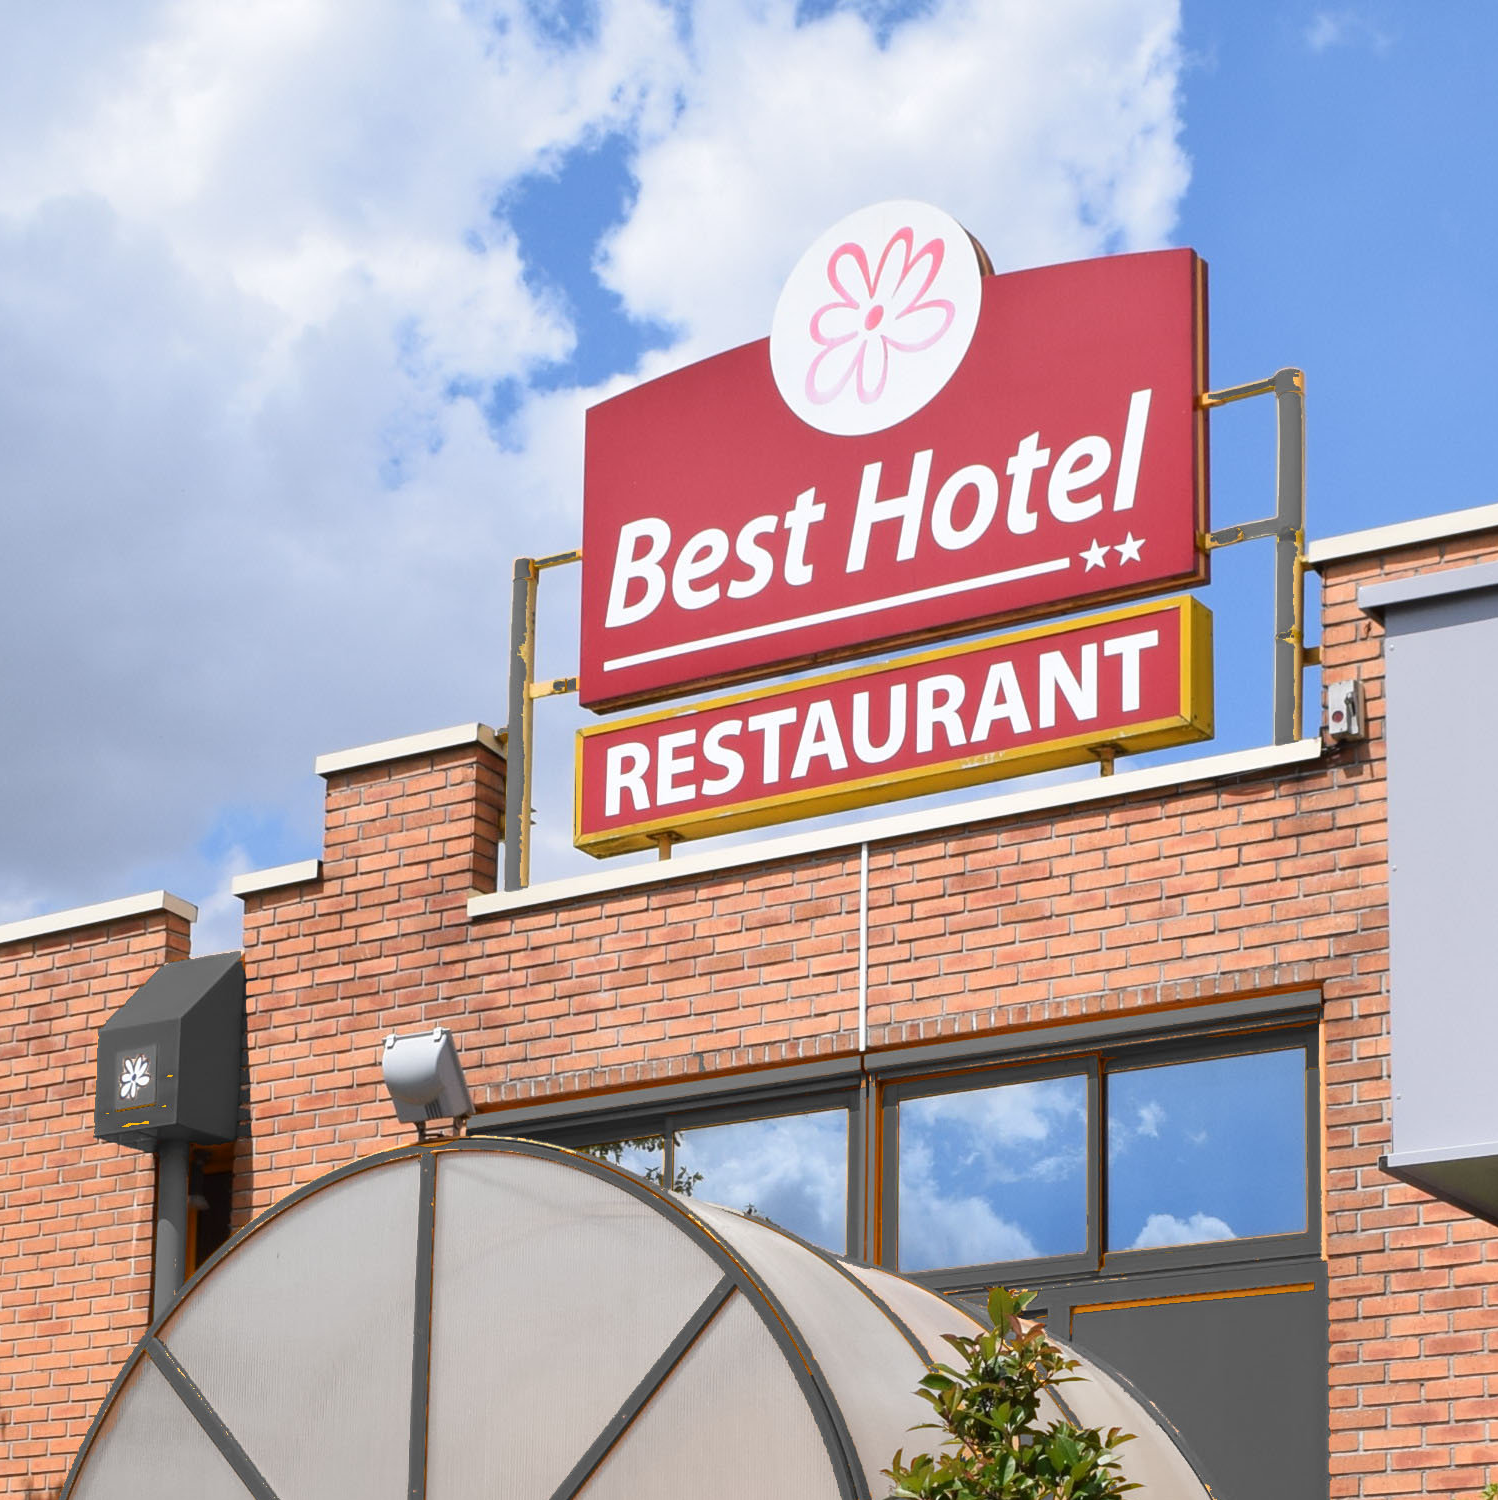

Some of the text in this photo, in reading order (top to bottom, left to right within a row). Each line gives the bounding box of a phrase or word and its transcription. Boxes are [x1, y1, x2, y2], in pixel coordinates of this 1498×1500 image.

[604, 388, 1152, 628] Best Hotel
[604, 629, 1159, 818] RESTAURANT
